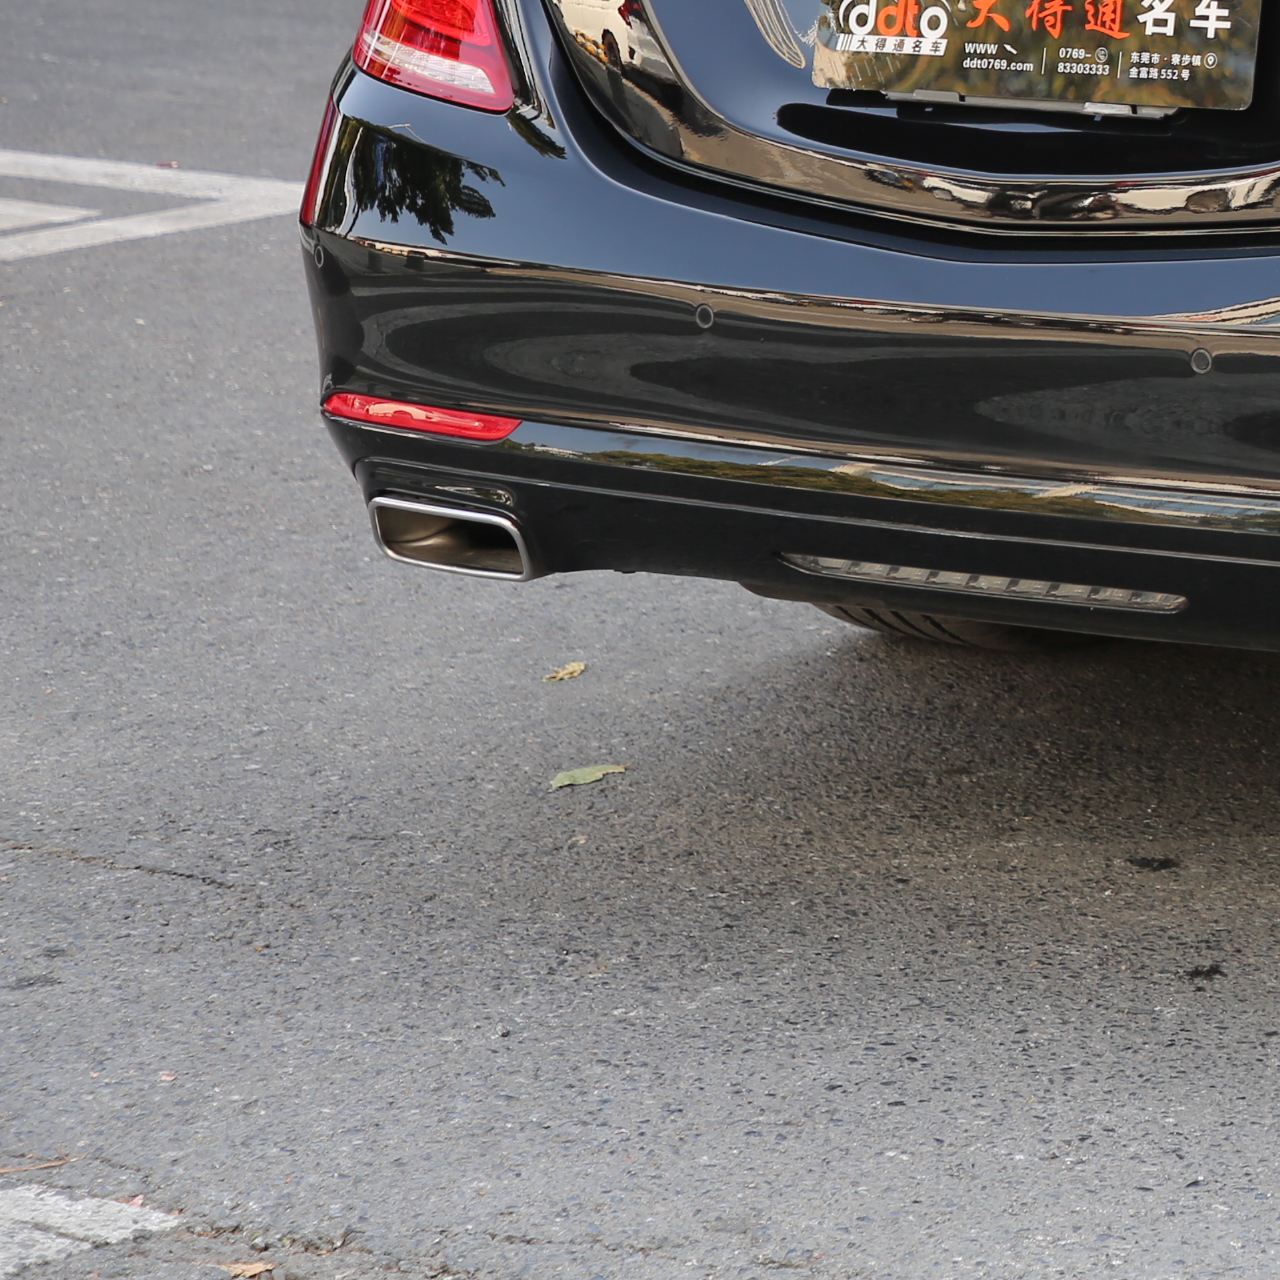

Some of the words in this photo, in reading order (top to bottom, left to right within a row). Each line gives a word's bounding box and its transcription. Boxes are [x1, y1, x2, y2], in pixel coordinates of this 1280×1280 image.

[855, 37, 943, 54] 大得通名车
[962, 57, 1035, 73] ddt0769.com
[1057, 62, 1110, 76] 83303333
